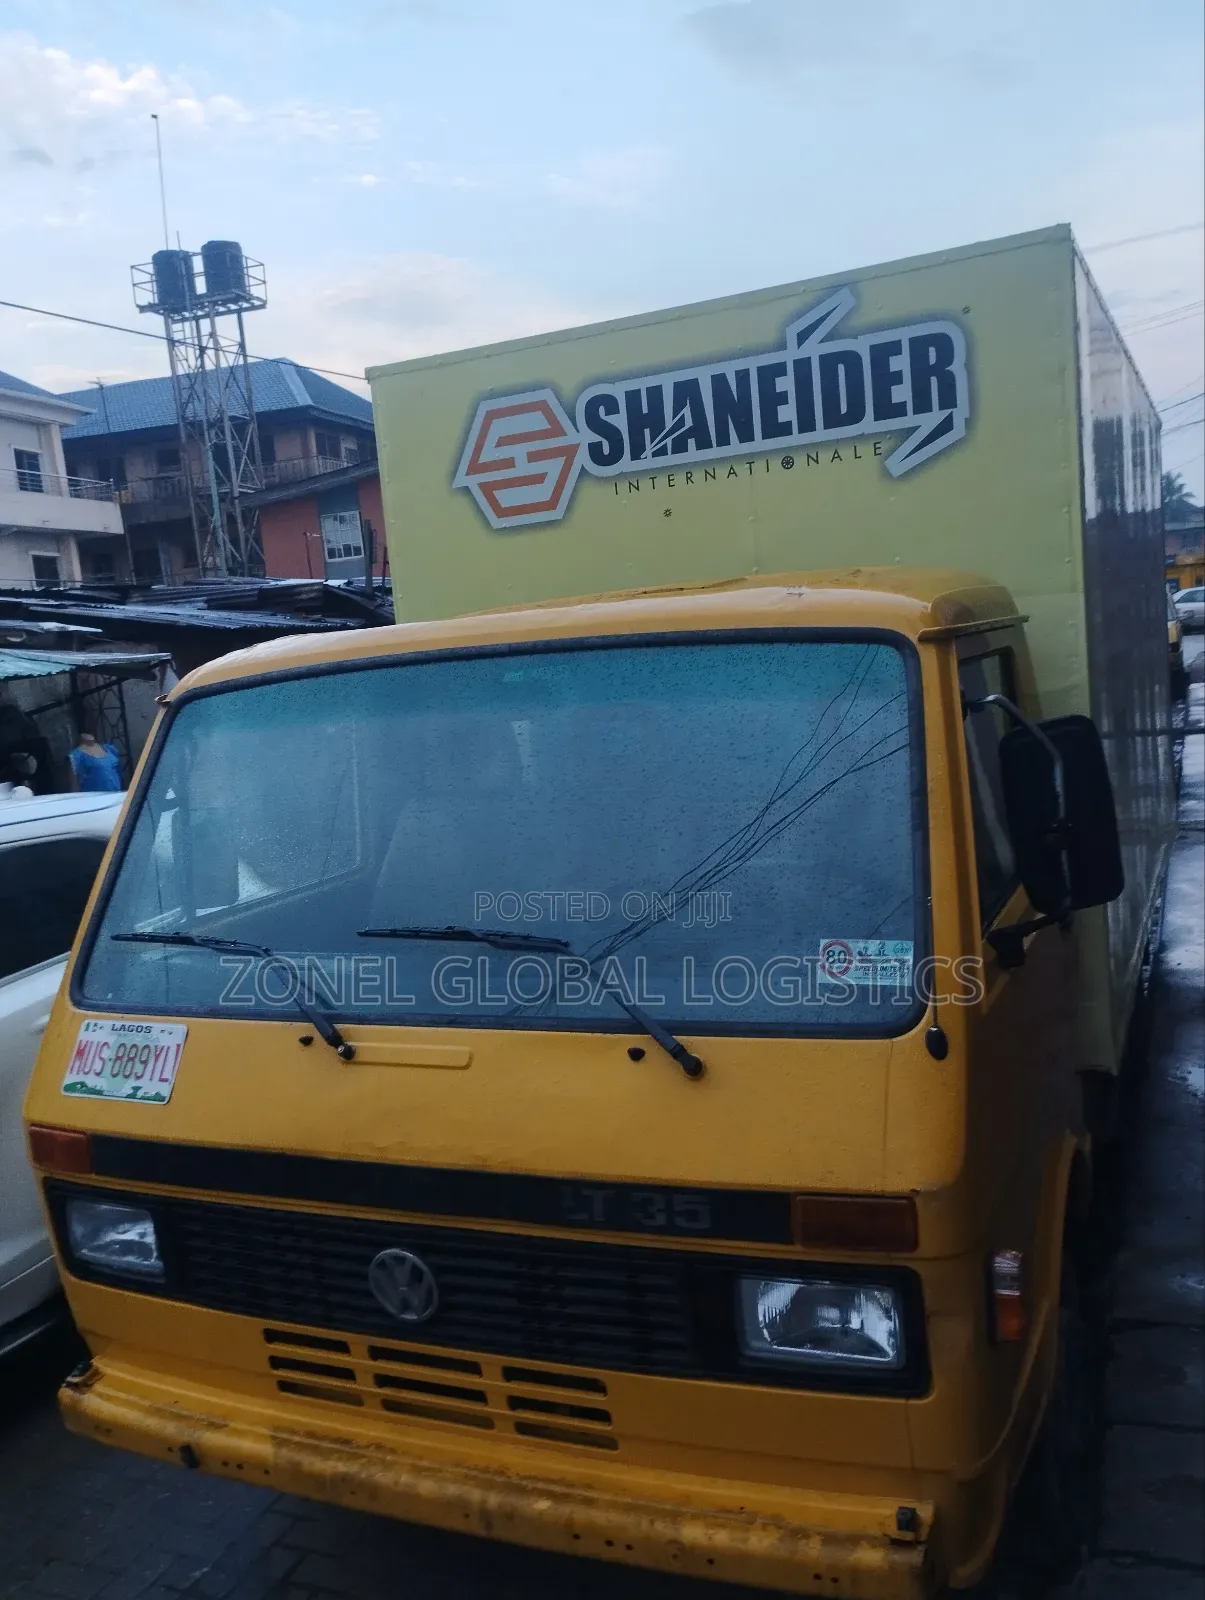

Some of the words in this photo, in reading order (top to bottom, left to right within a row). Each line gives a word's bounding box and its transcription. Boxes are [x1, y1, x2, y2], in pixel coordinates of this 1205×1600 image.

[584, 304, 957, 467] SHANEIDER
[111, 1023, 153, 1034] LAGOS
[630, 1192, 712, 1230] 35
